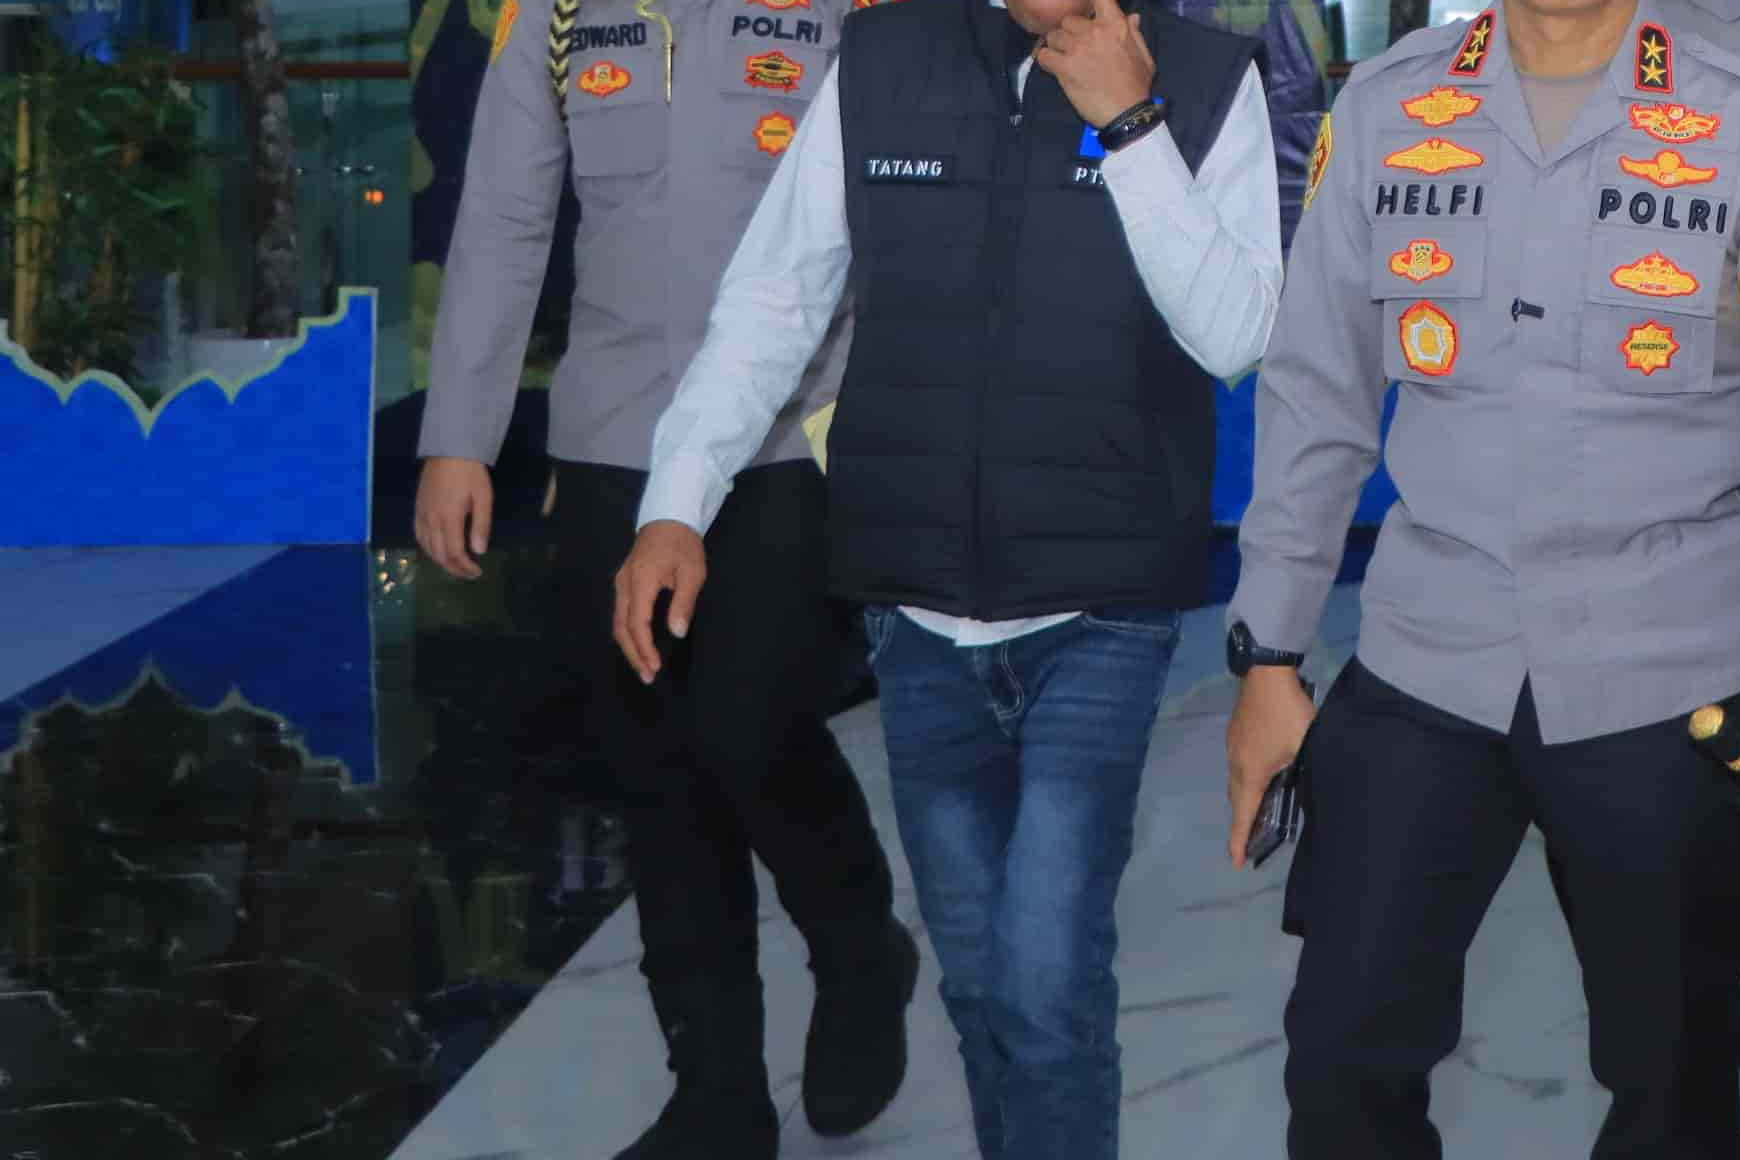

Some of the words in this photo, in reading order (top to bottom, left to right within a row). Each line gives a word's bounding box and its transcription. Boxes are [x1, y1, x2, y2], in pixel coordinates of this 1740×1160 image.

[732, 15, 822, 44] POLRI
[869, 159, 943, 176] TATANG
[1376, 183, 1484, 216] HELFI
[1598, 188, 1728, 234] POLRI
